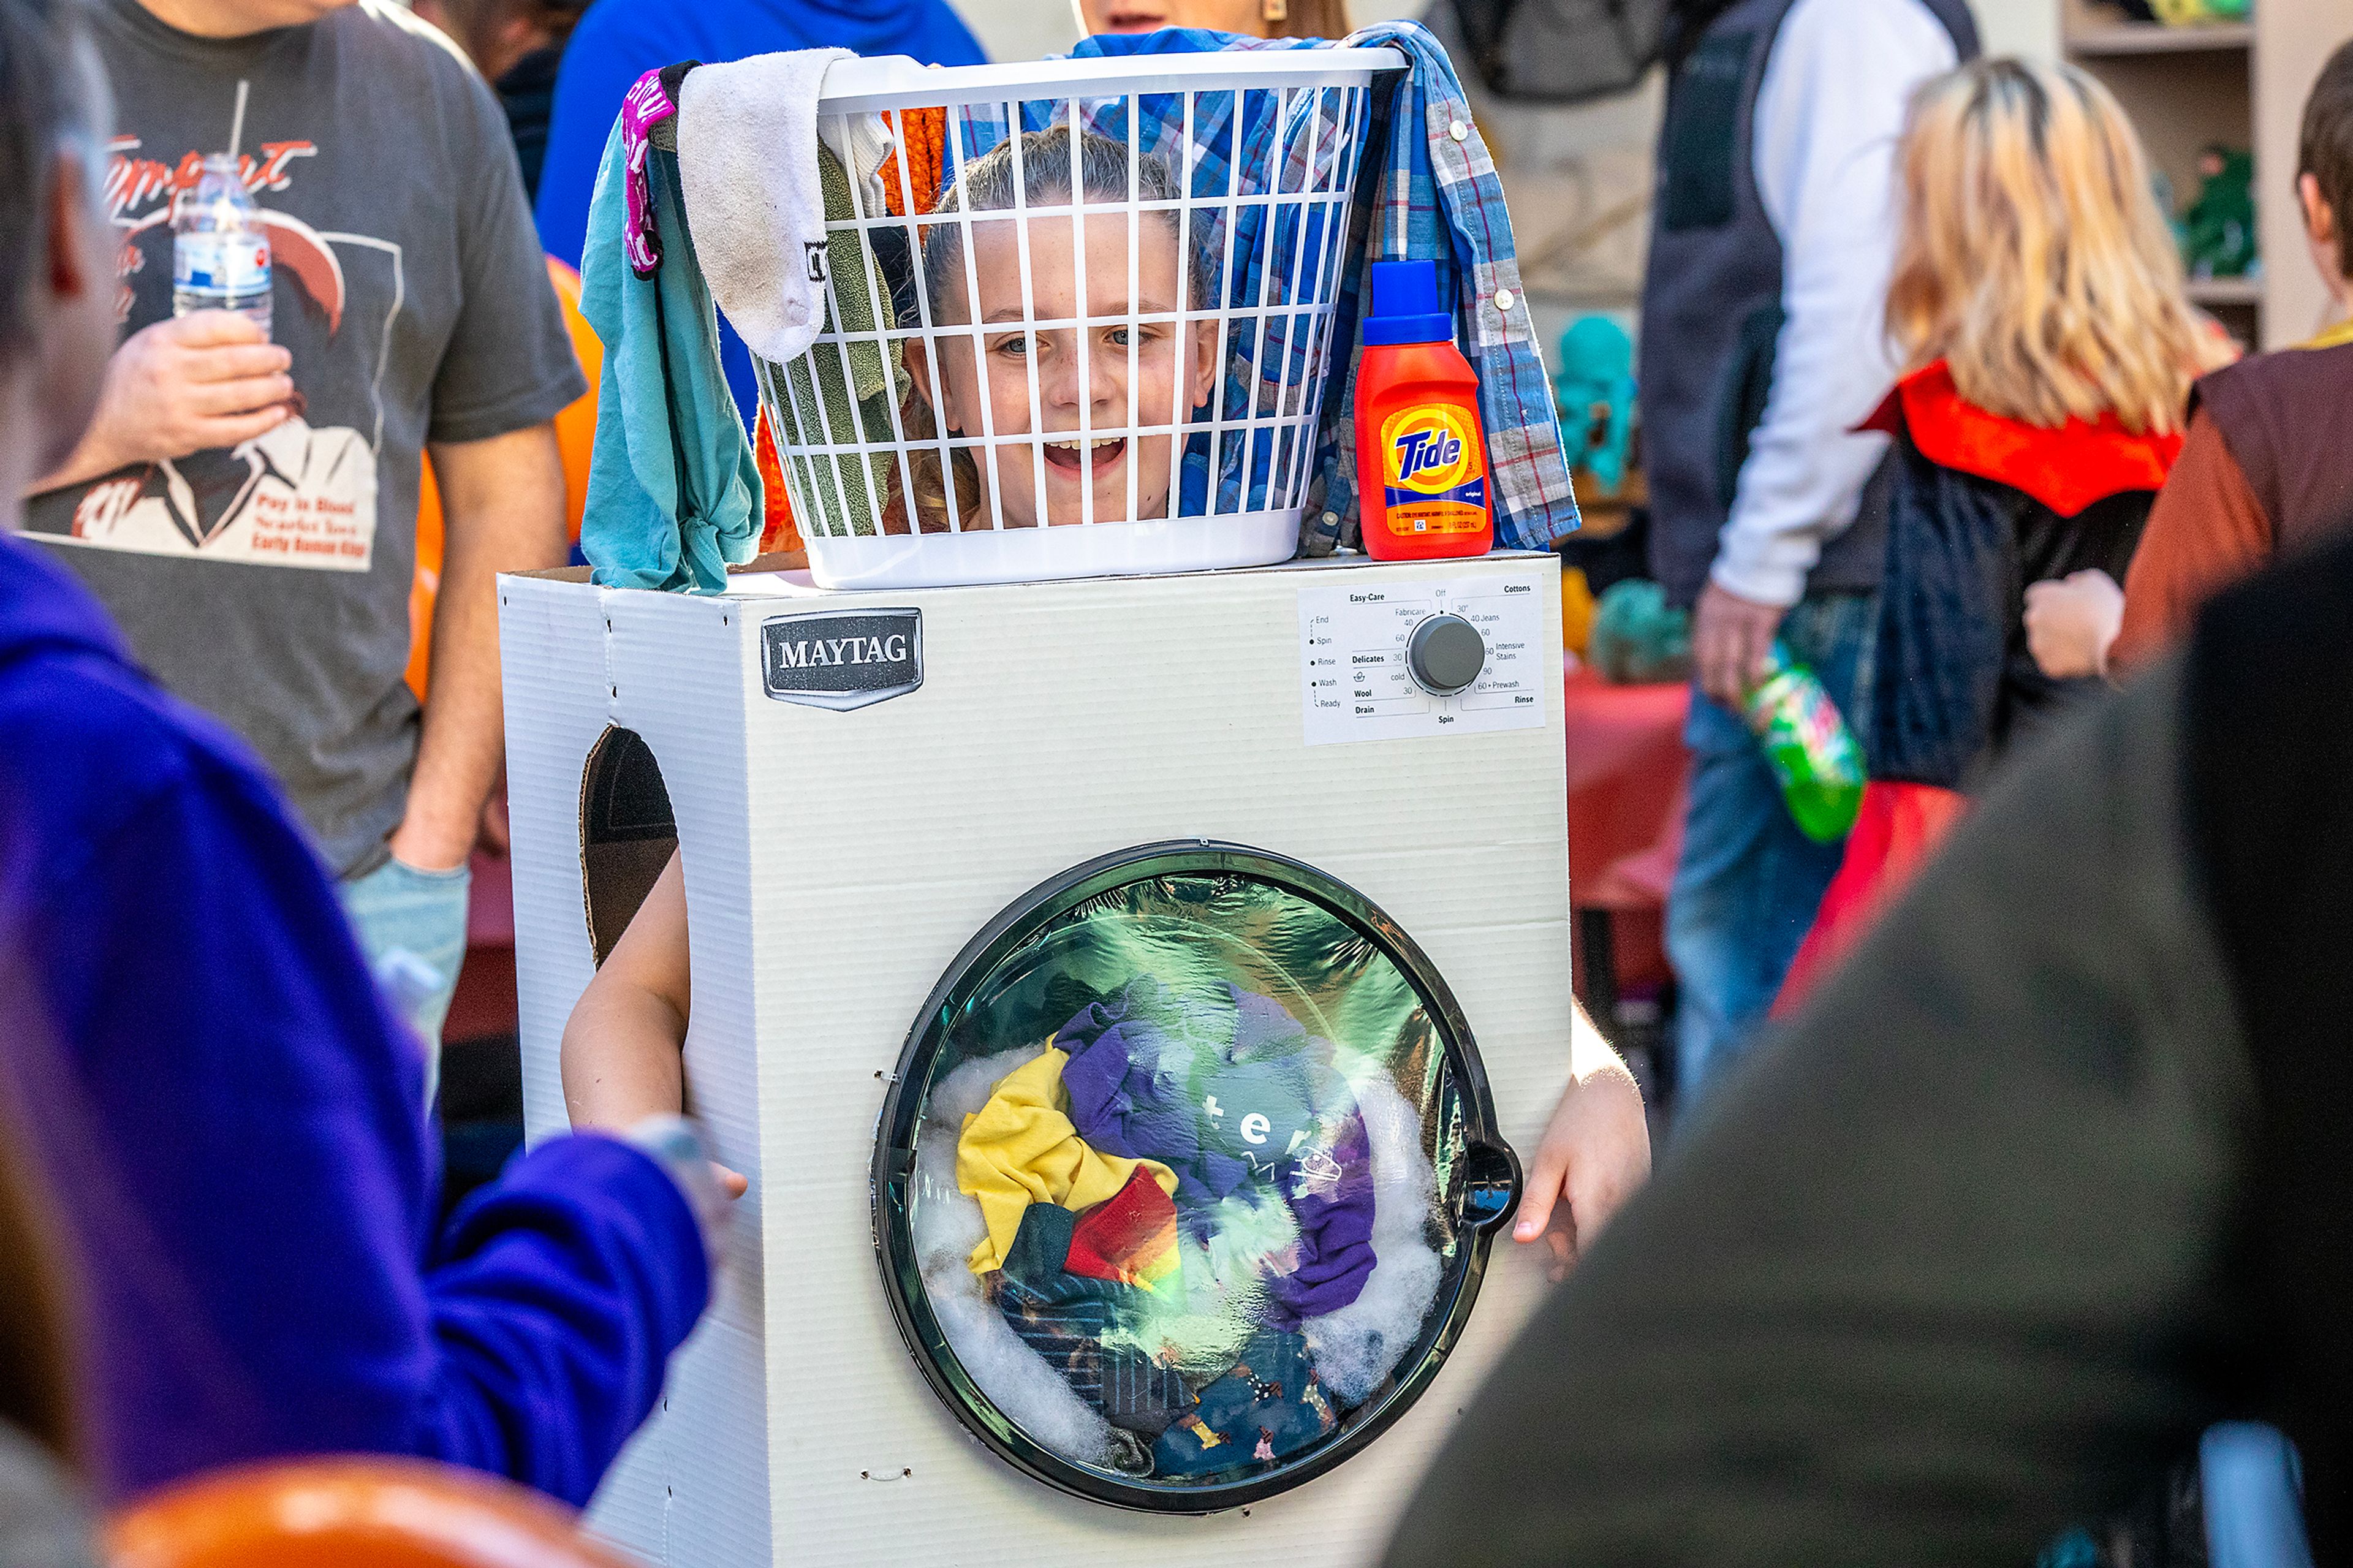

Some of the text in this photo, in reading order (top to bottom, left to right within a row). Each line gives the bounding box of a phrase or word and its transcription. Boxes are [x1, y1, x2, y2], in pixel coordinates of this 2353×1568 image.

[1395, 429, 1461, 482] Tide
[1435, 589, 1446, 597] Off
[1349, 593, 1385, 604] Easy-Care
[1317, 637, 1332, 645] Spin
[779, 634, 907, 669] MAYTAG
[1352, 653, 1403, 664] Delicates 30
[1492, 680, 1520, 689] Prewash
[1354, 689, 1372, 697] Wool
[1320, 699, 1341, 708] Ready
[1438, 715, 1454, 724] Spin
